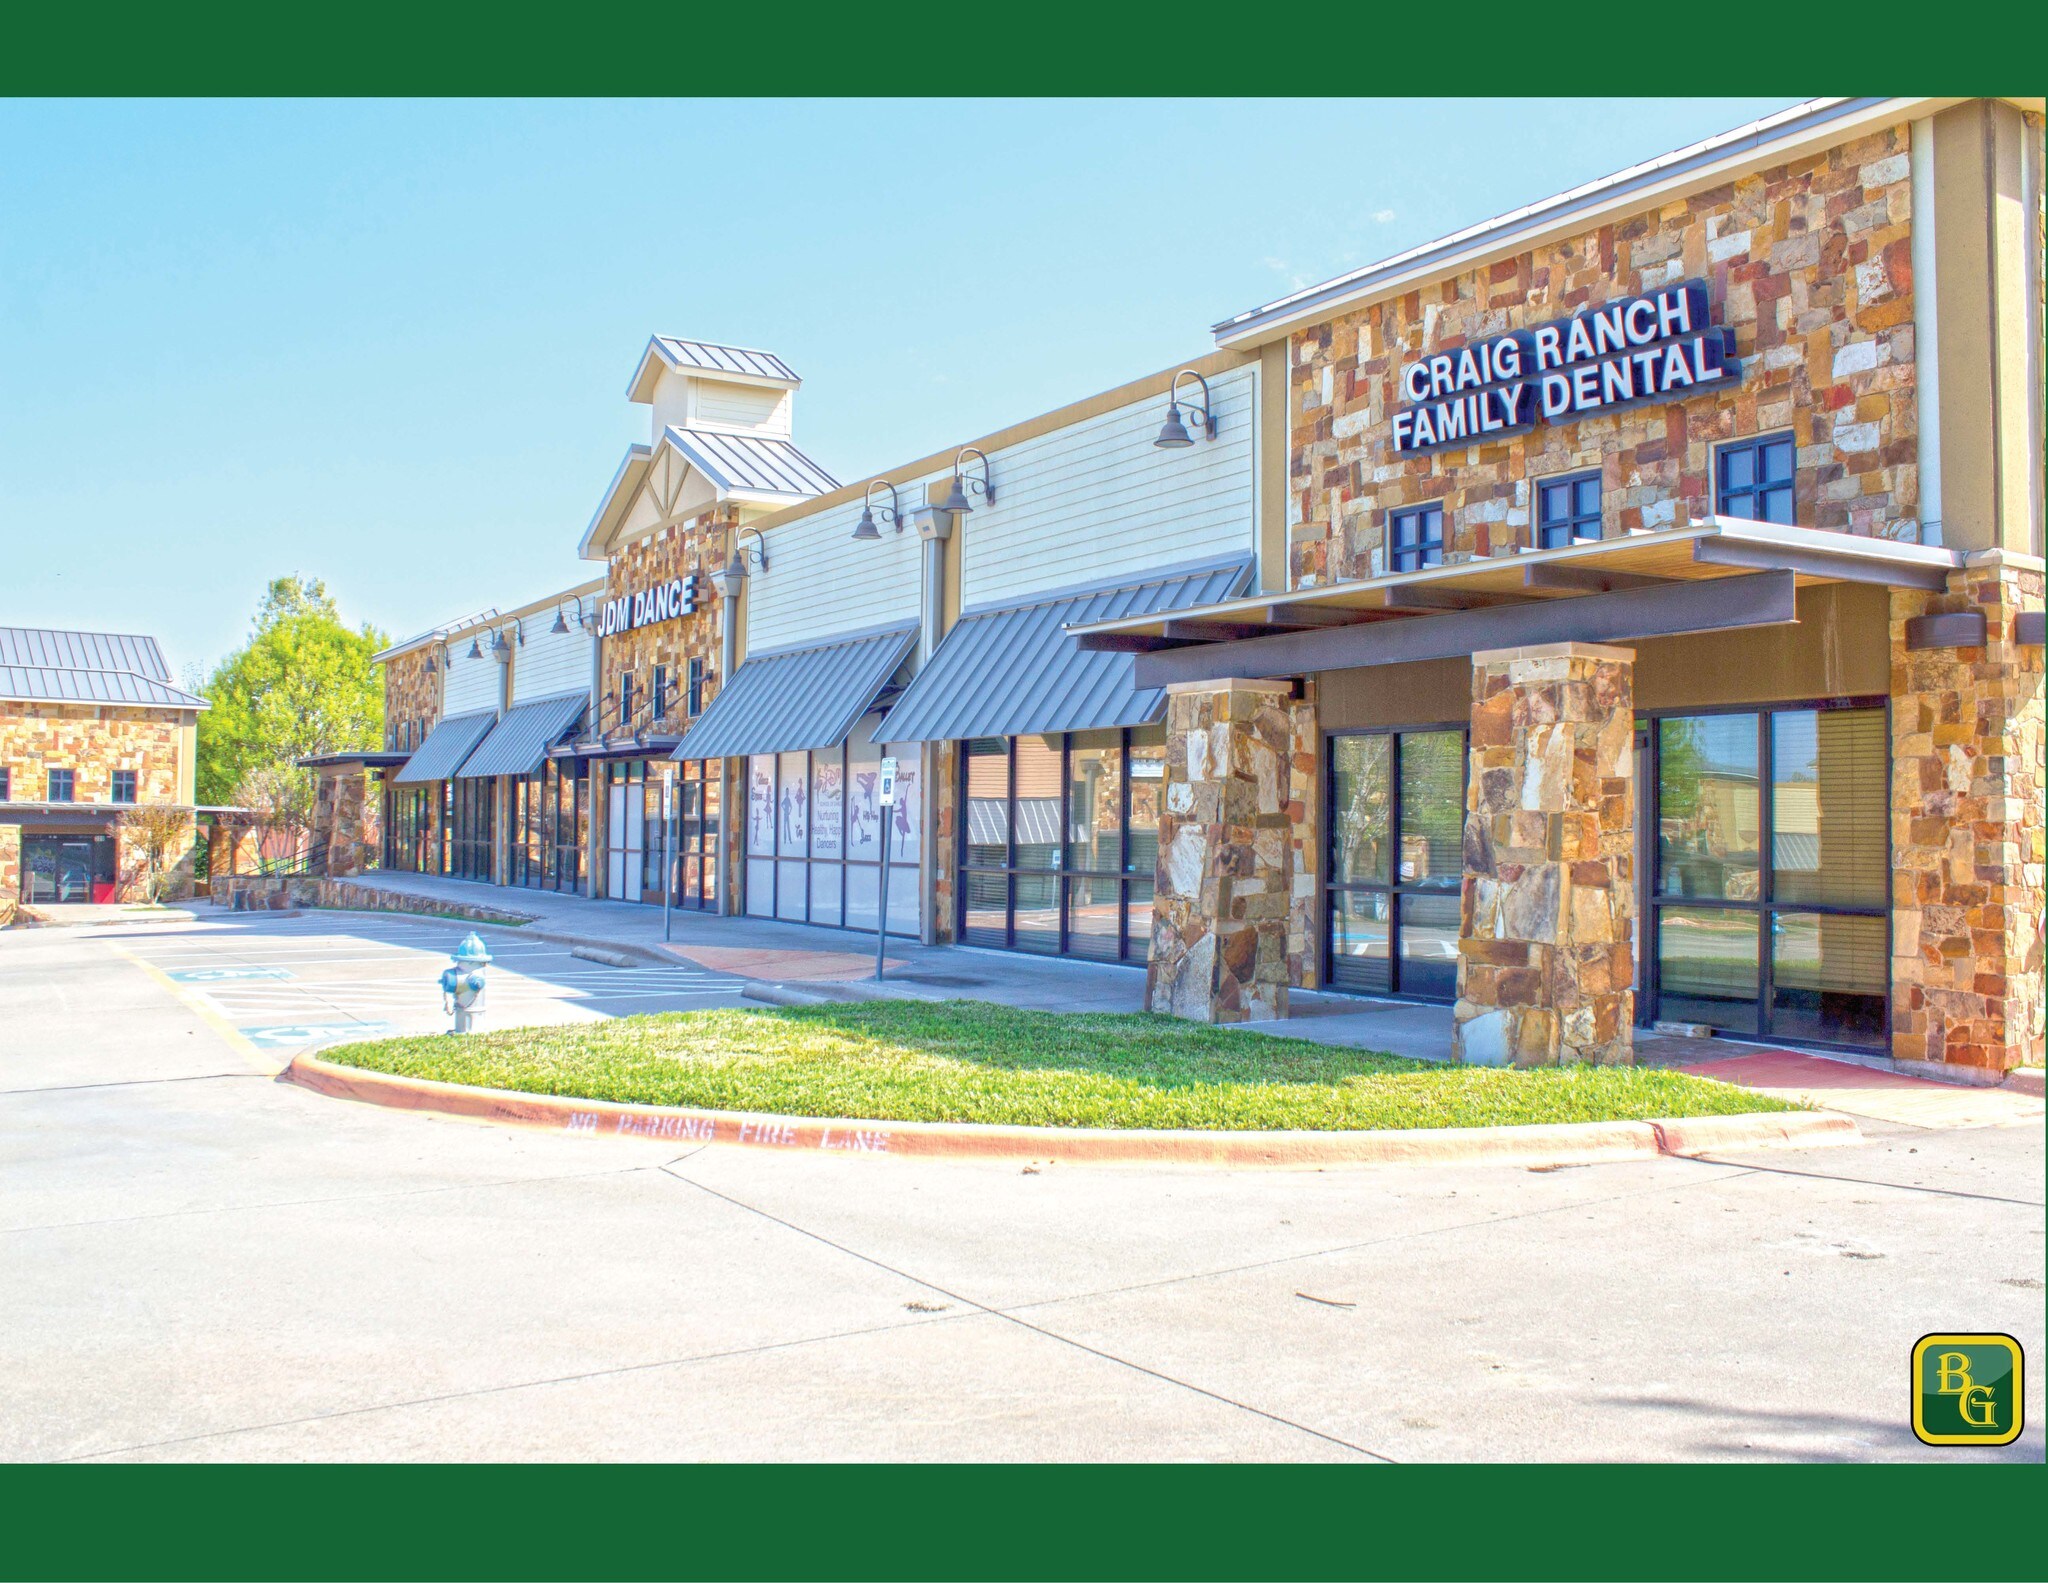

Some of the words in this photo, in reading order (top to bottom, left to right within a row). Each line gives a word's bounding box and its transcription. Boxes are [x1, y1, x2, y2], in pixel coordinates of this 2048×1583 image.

[1405, 337, 1522, 402] CRAIG
[1534, 287, 1692, 371] RANCH
[1391, 382, 1524, 452] FAMILY
[1541, 336, 1723, 418] DENTAL
[597, 595, 632, 638] JDM
[633, 575, 697, 628] DANCE
[817, 810, 839, 824] Nurturing
[816, 838, 837, 849] Dancers
[565, 1111, 599, 1131] NO
[616, 1113, 715, 1141] PARKING
[738, 1119, 800, 1145] FIRE
[820, 1126, 891, 1153] LANE
